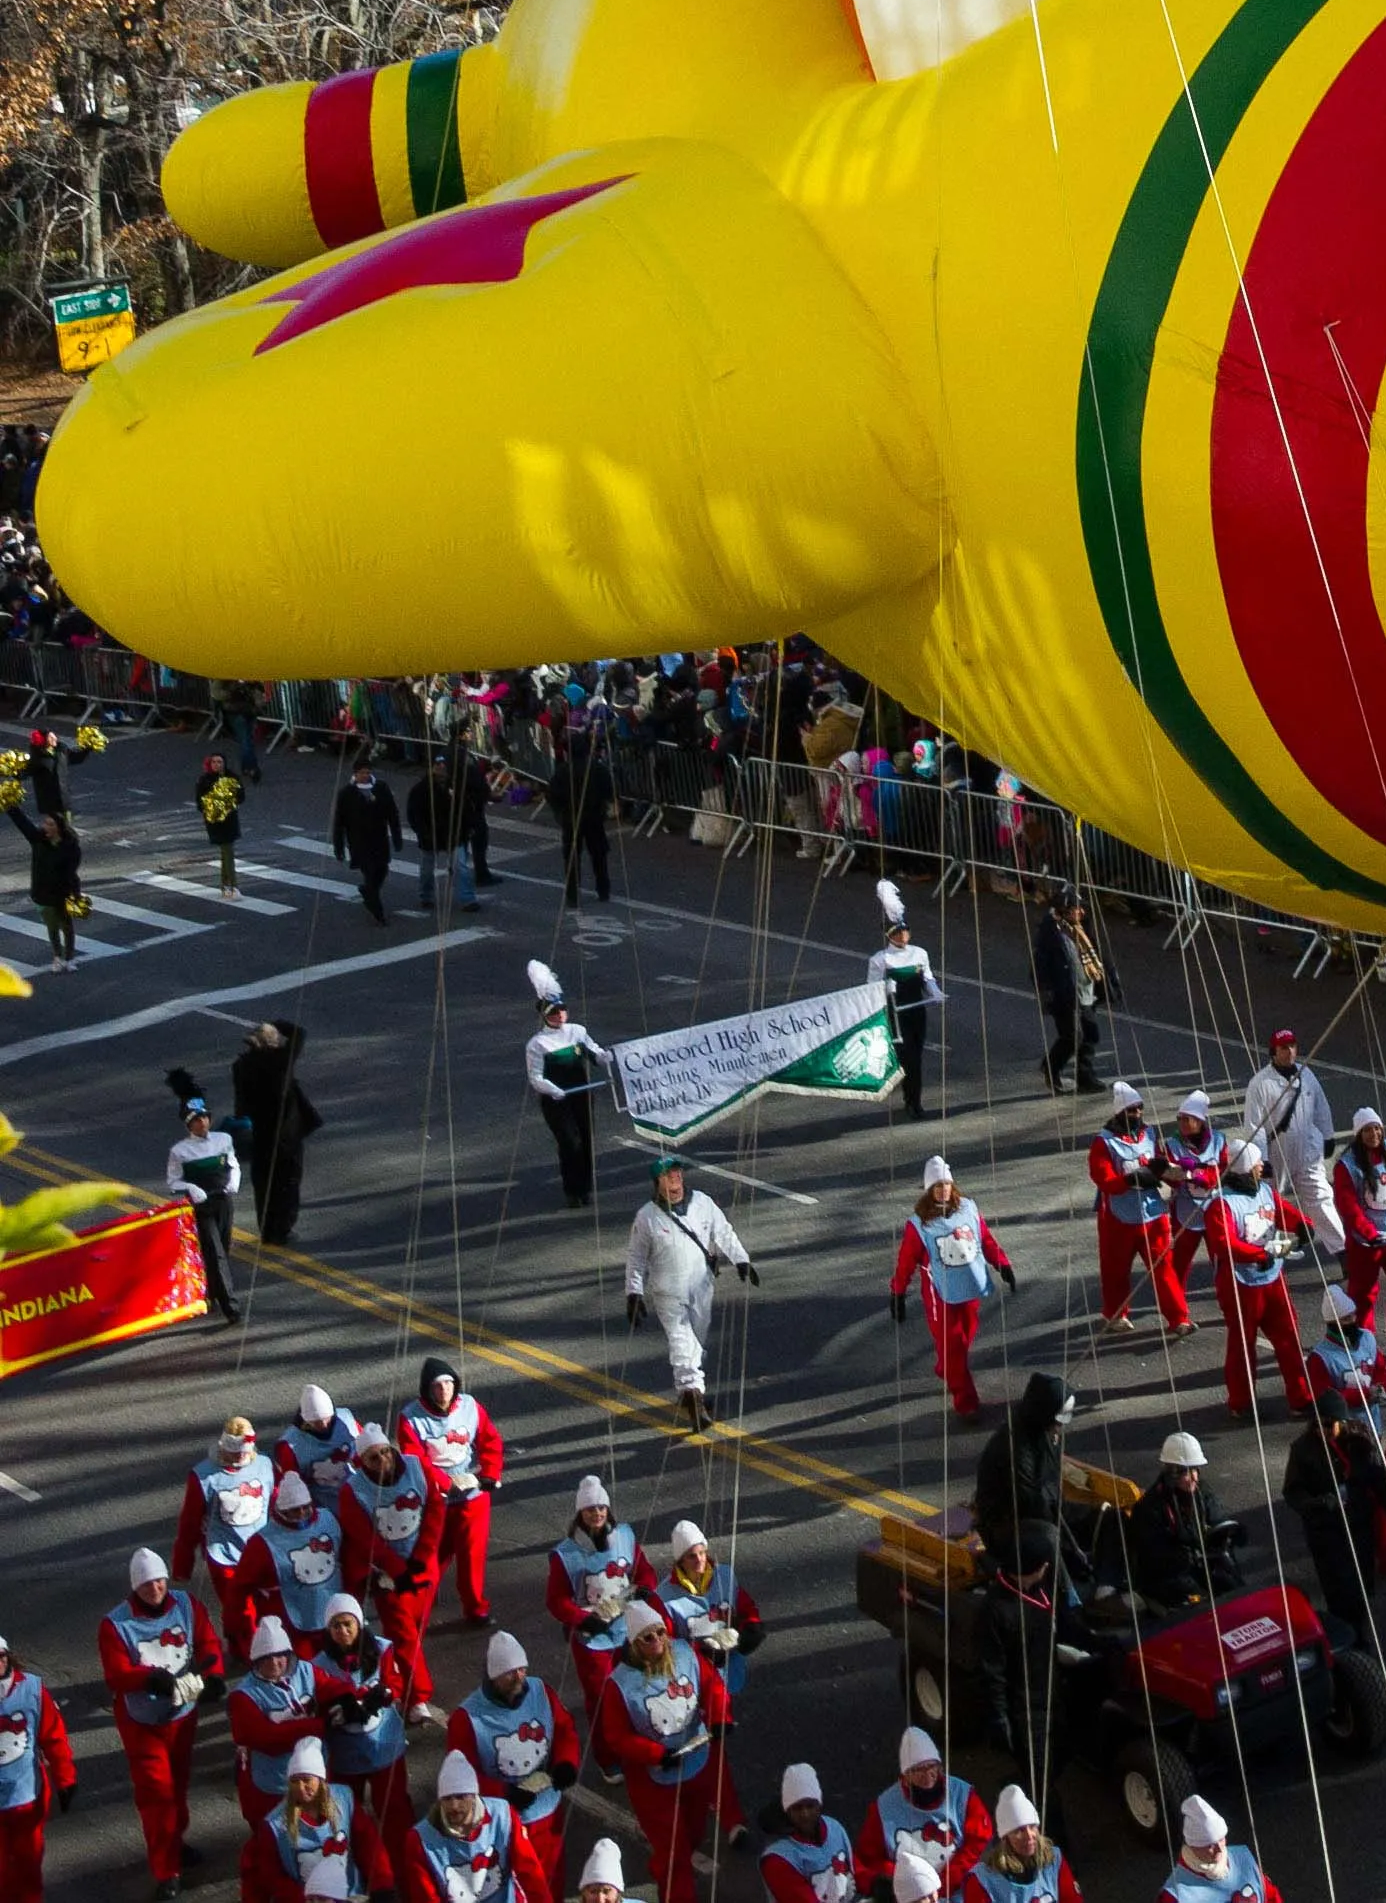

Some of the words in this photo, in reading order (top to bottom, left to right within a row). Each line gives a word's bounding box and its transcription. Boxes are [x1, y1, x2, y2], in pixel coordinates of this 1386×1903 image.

[61, 301, 81, 316] EAST
[624, 1034, 713, 1073] Concord
[716, 1024, 761, 1053] High
[767, 1005, 831, 1040] School
[630, 1068, 701, 1093] Marching
[708, 1048, 788, 1074] Minutemen
[1231, 1625, 1278, 1647] TRACTOR
